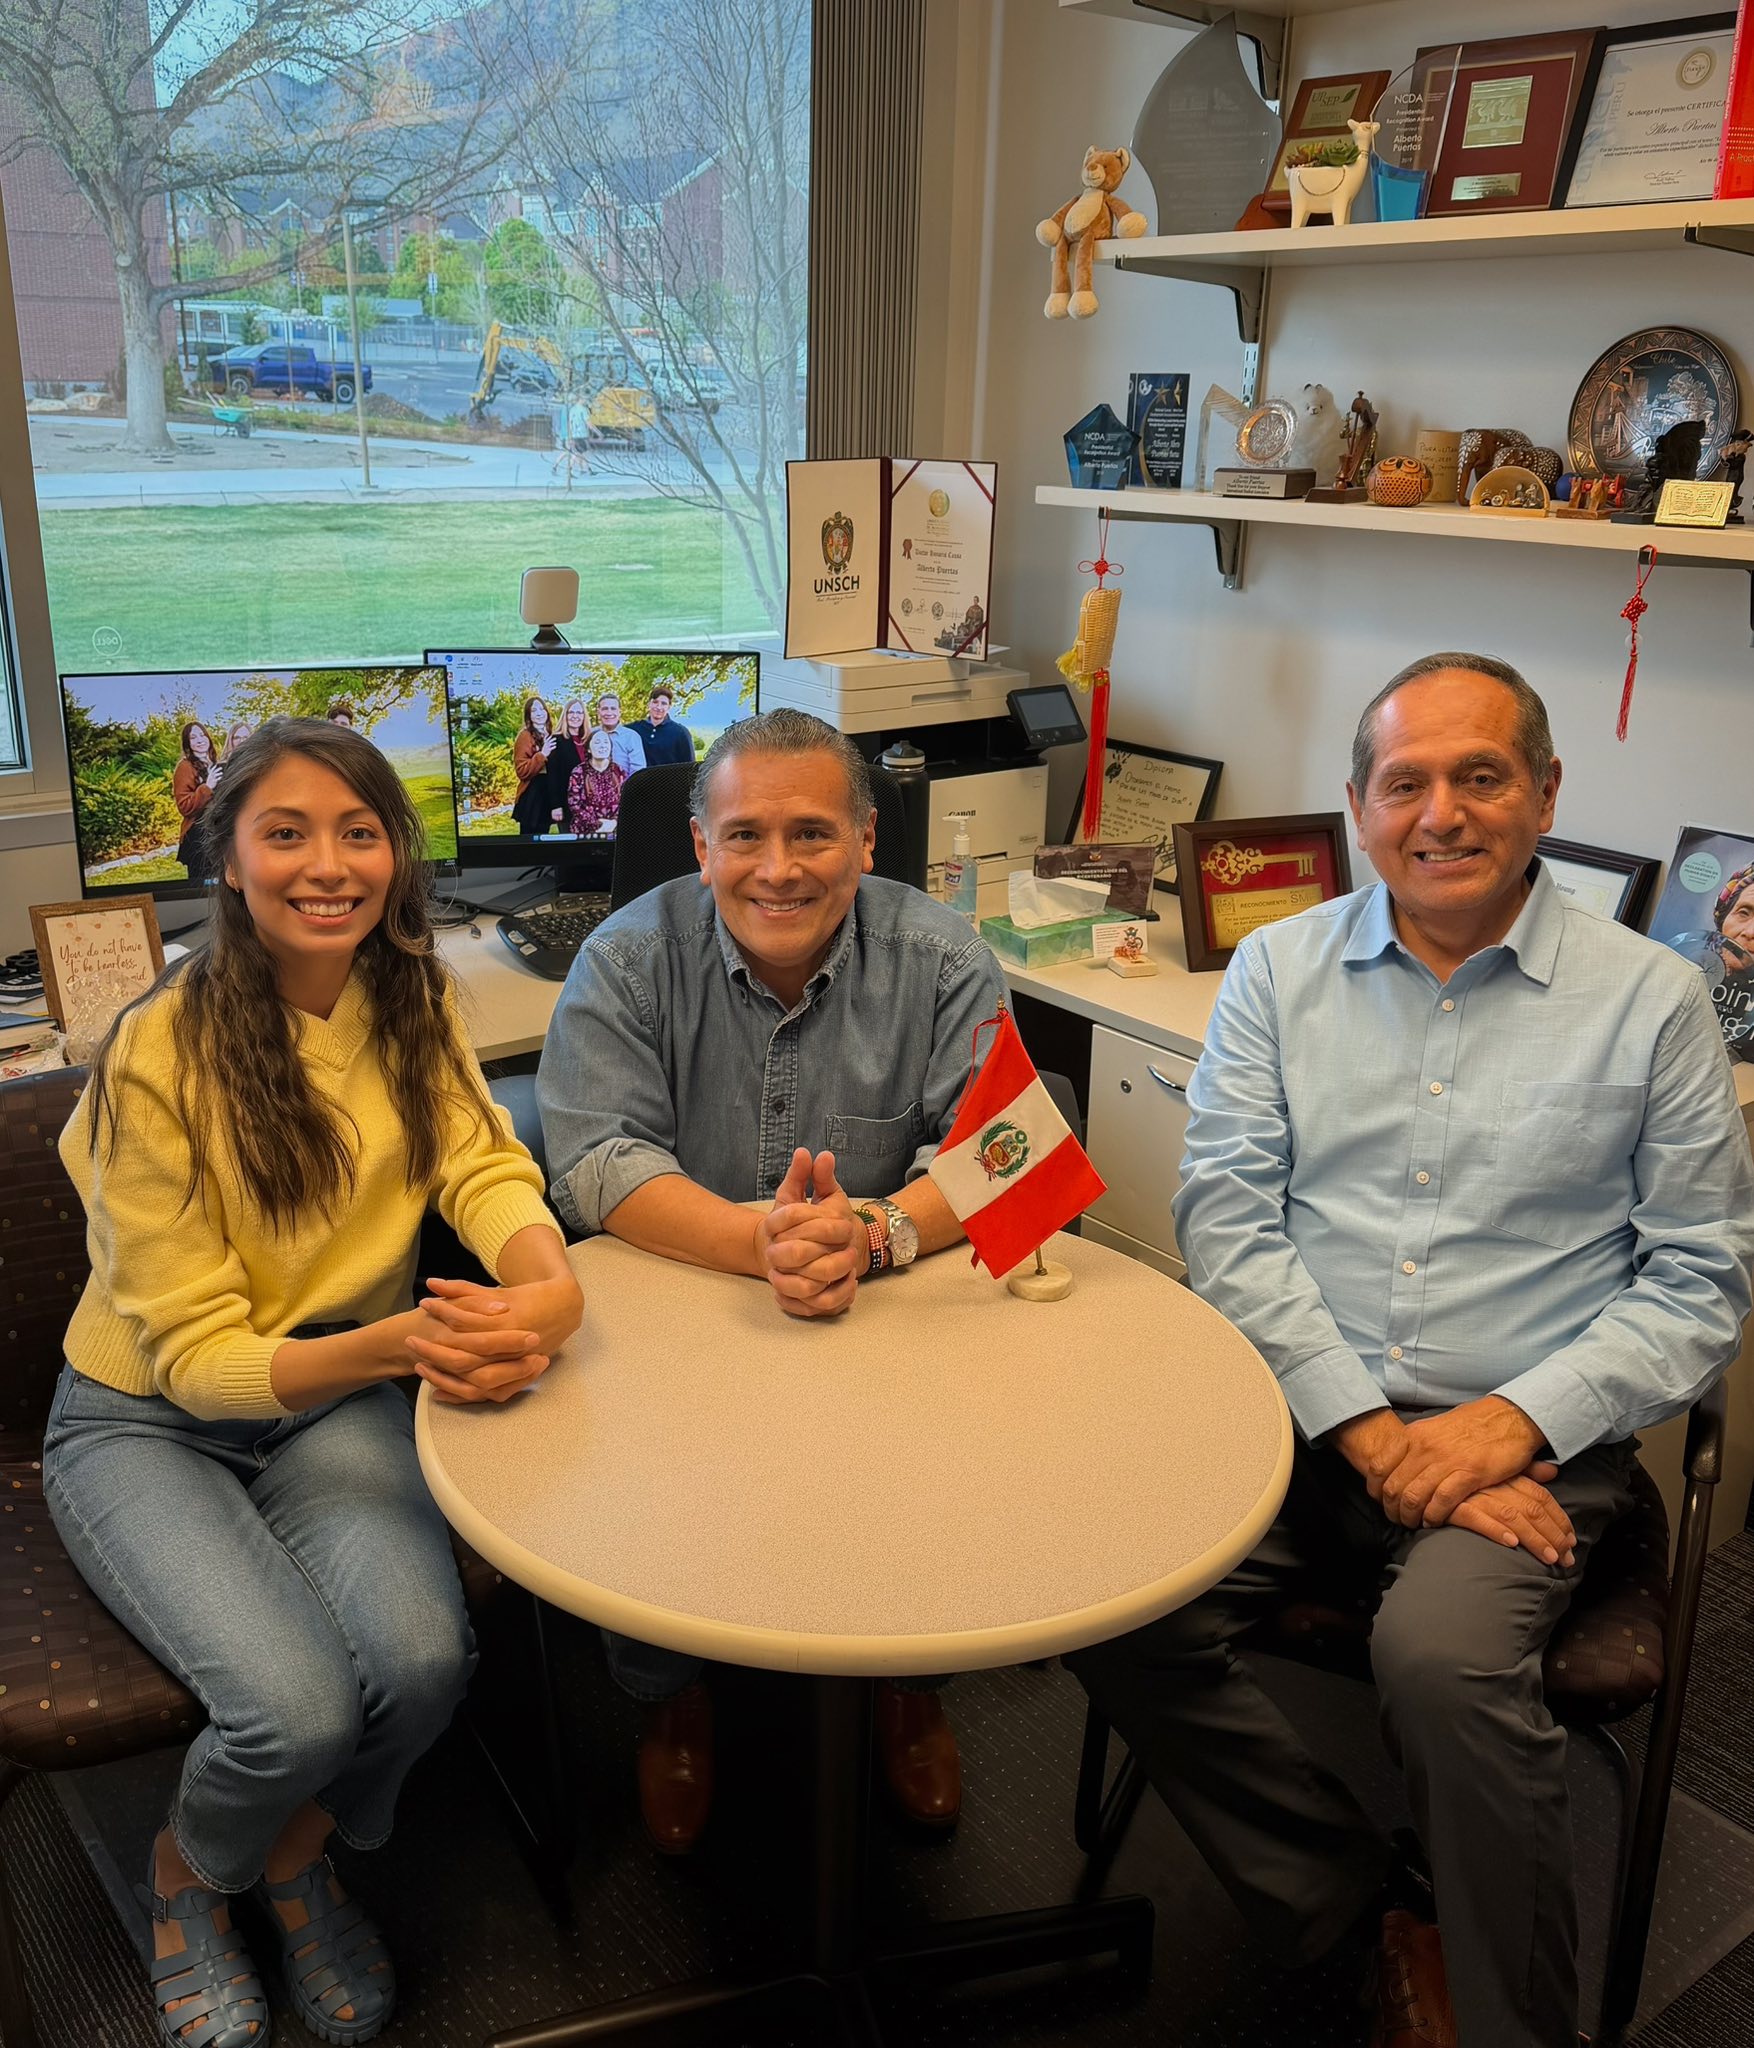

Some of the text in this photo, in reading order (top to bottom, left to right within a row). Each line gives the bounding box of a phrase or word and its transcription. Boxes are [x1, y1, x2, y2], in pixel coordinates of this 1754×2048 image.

[1394, 93, 1424, 104] NCDA
[1645, 120, 1680, 136] Alberto
[1393, 134, 1422, 143] Alberto
[1393, 143, 1421, 152] Puertas
[1084, 432, 1105, 441] NCDA
[814, 575, 860, 594] UNSCH
[1240, 899, 1287, 909] RECONOCIMIENTO
[60, 937, 143, 963] You do not have
